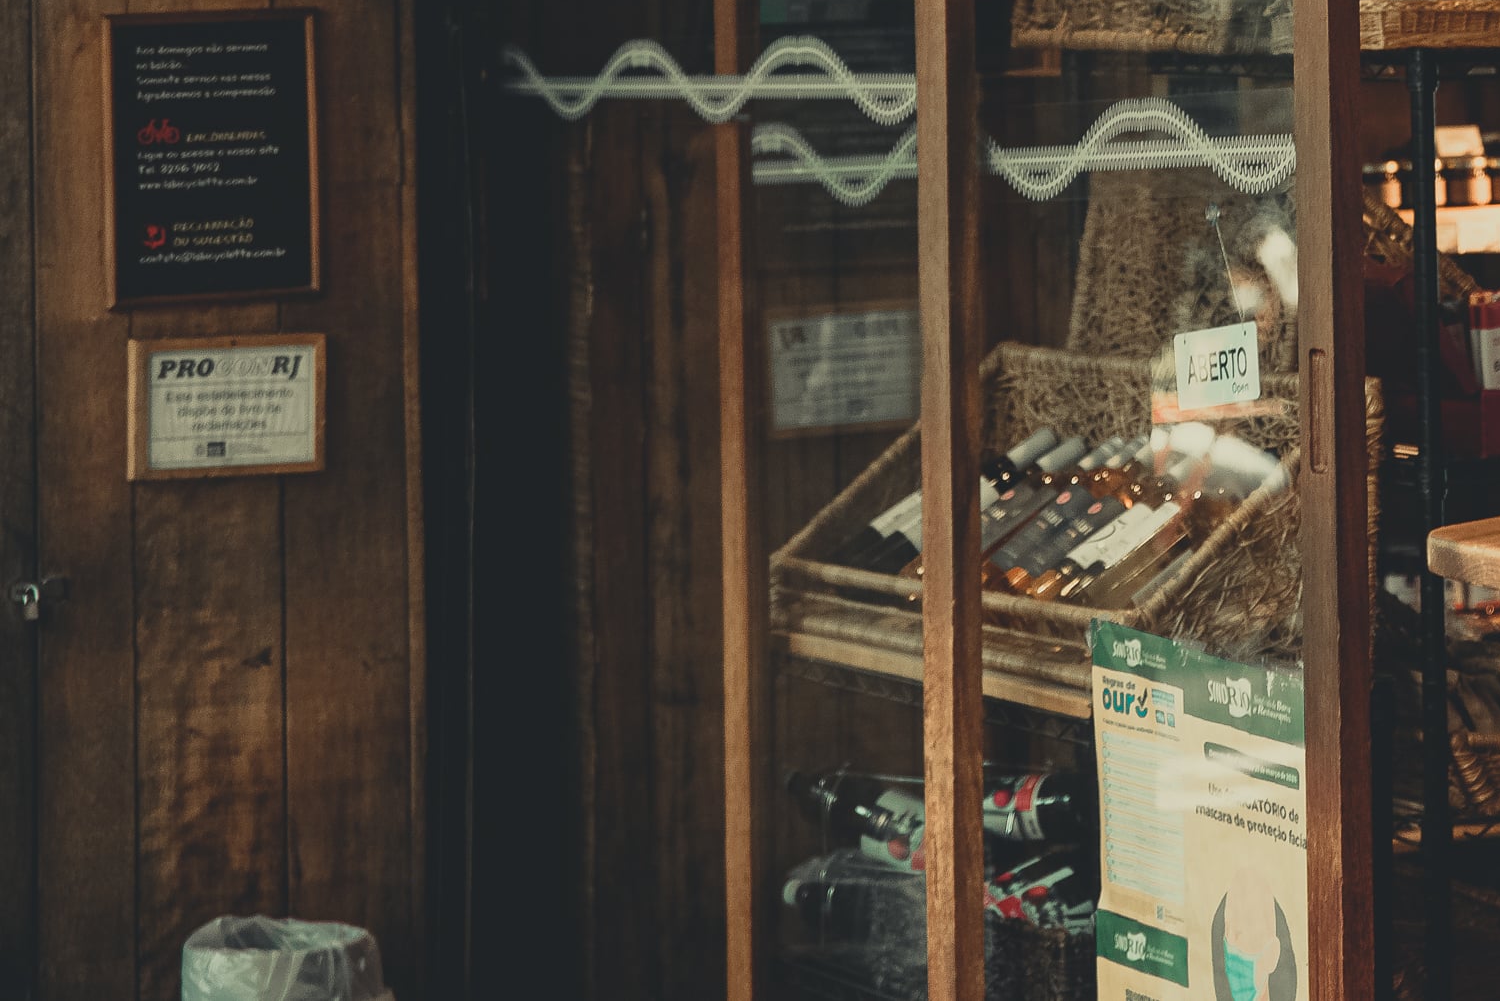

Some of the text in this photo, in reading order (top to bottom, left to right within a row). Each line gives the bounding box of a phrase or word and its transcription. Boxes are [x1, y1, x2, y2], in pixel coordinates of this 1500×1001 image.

[272, 355, 303, 380] RJ
[1187, 346, 1248, 385] ABERTO
[1234, 813, 1246, 829] de
[1289, 808, 1300, 824] de
